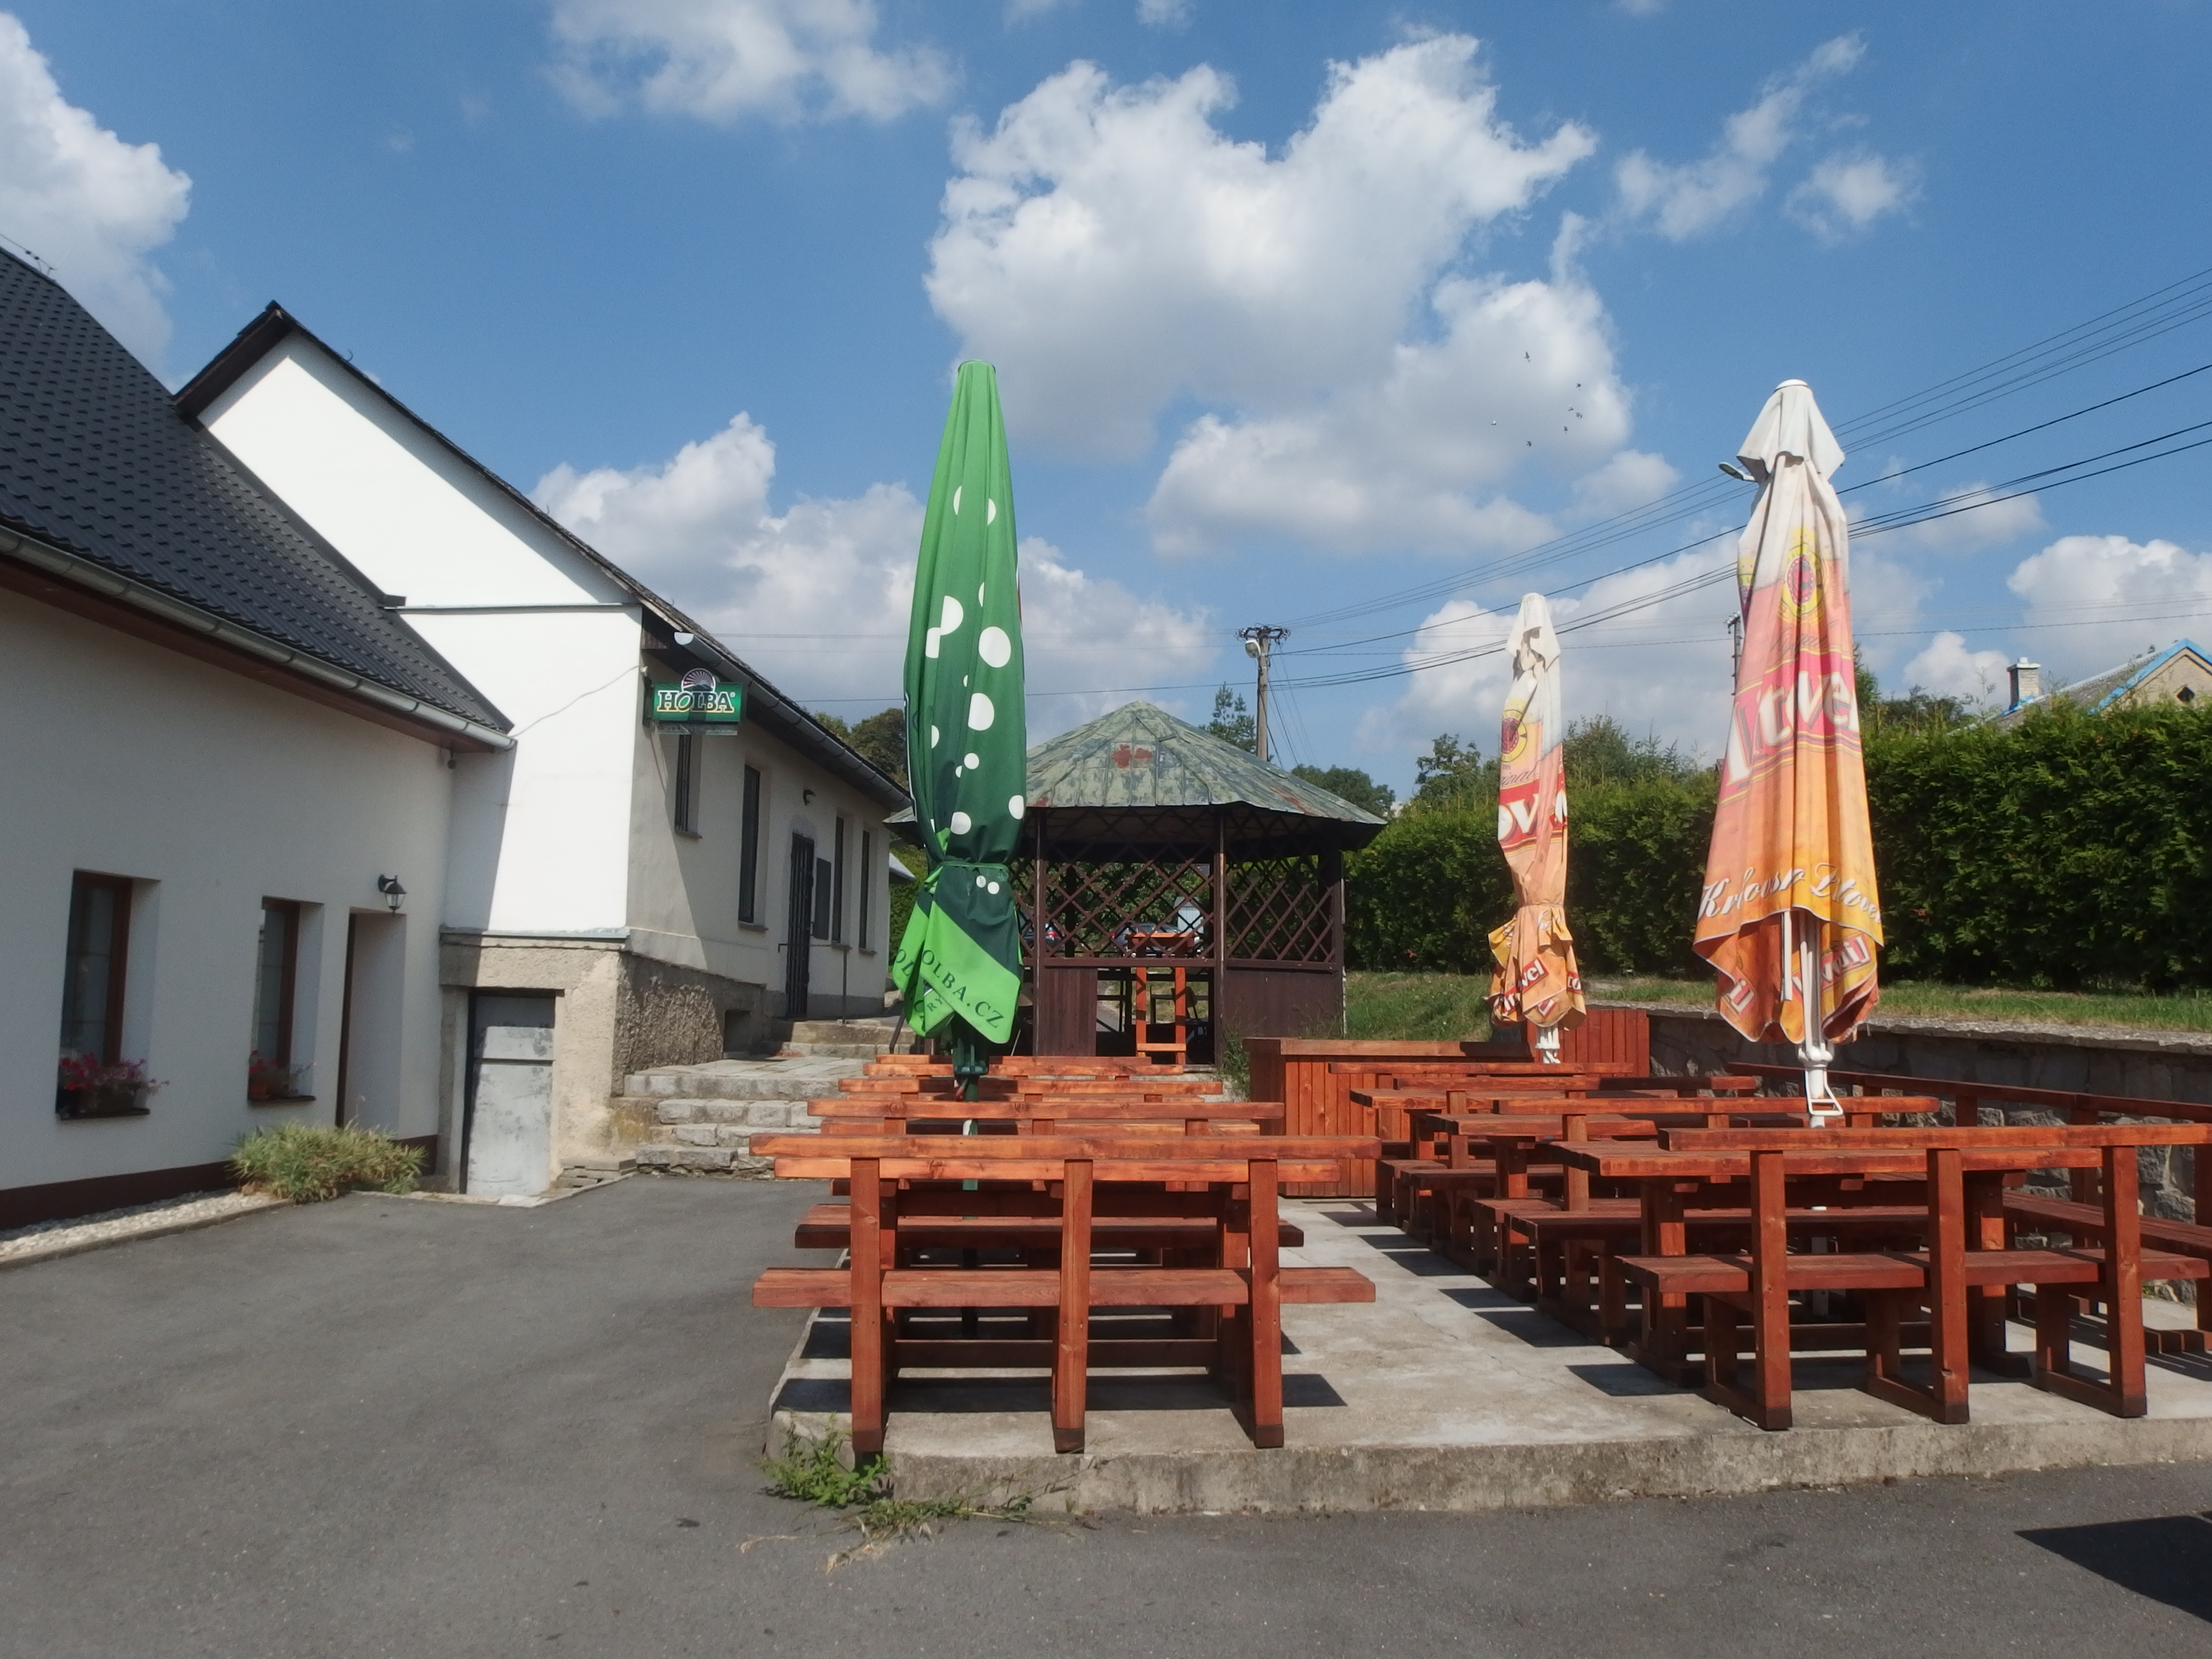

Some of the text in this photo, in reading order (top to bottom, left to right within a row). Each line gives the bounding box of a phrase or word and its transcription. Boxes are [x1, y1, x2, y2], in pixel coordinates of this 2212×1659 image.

[657, 690, 735, 713] HOLBA
[1726, 671, 1860, 787] Ltvel
[921, 949, 1004, 1029] OLBA.CZ
